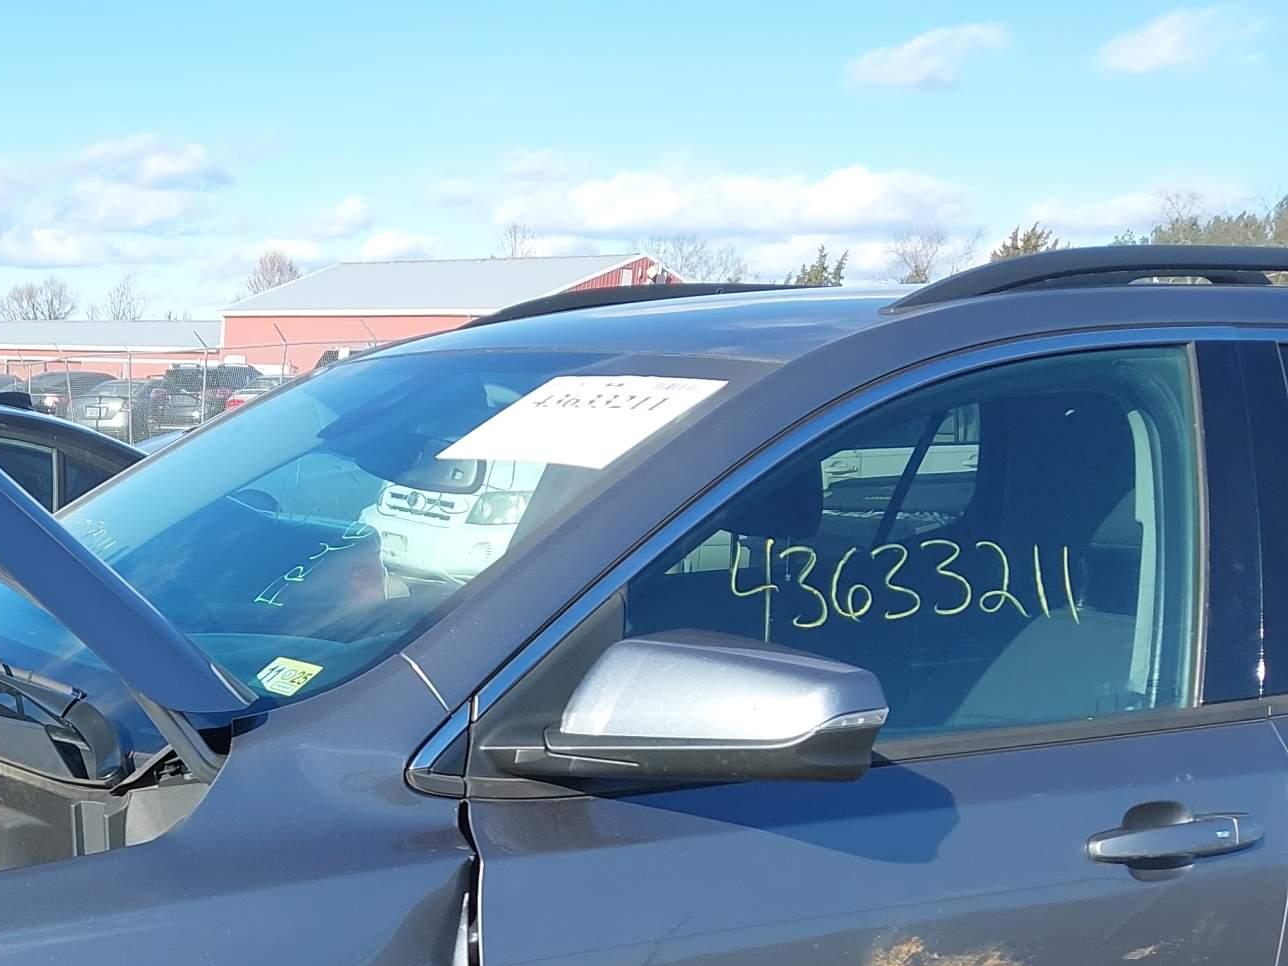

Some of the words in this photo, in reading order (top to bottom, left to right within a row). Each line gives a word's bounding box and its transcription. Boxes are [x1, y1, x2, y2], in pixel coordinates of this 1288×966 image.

[731, 538, 1080, 643] 43633211
[261, 665, 286, 684] 11
[289, 670, 314, 685] 25
